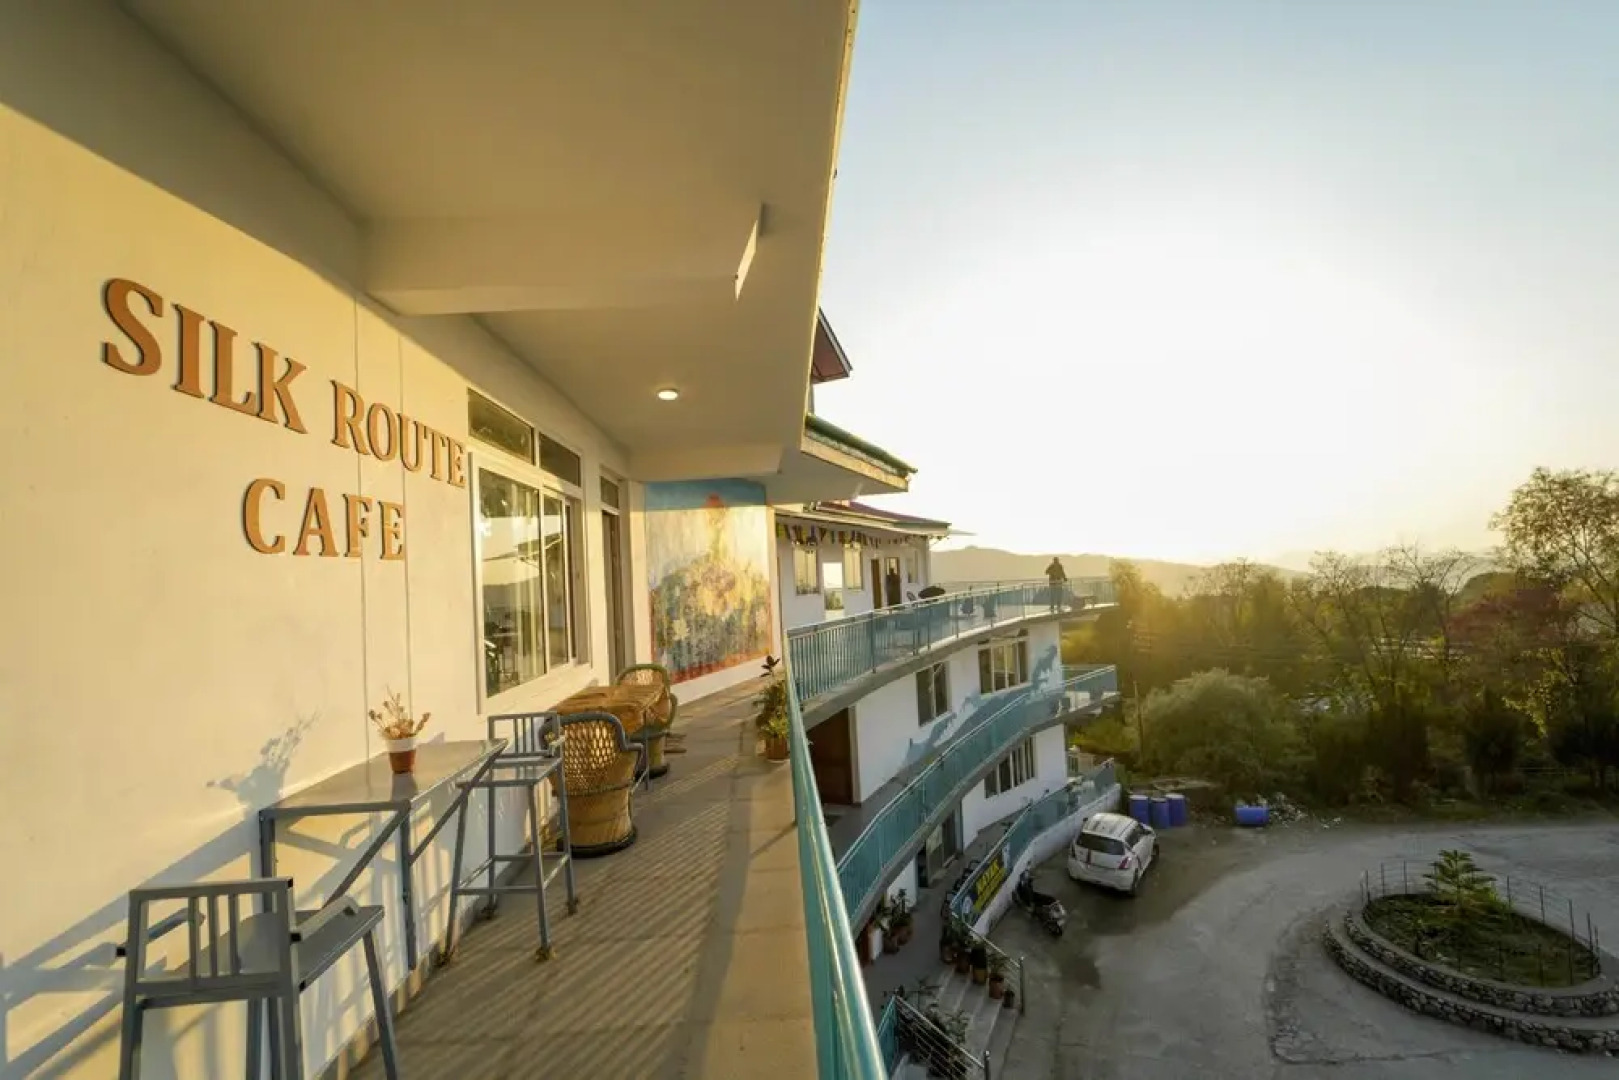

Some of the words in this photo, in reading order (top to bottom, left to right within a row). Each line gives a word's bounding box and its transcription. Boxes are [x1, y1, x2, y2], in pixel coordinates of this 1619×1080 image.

[102, 278, 308, 434] SILK
[330, 380, 466, 488] ROUTE
[242, 478, 405, 560] CAFE
